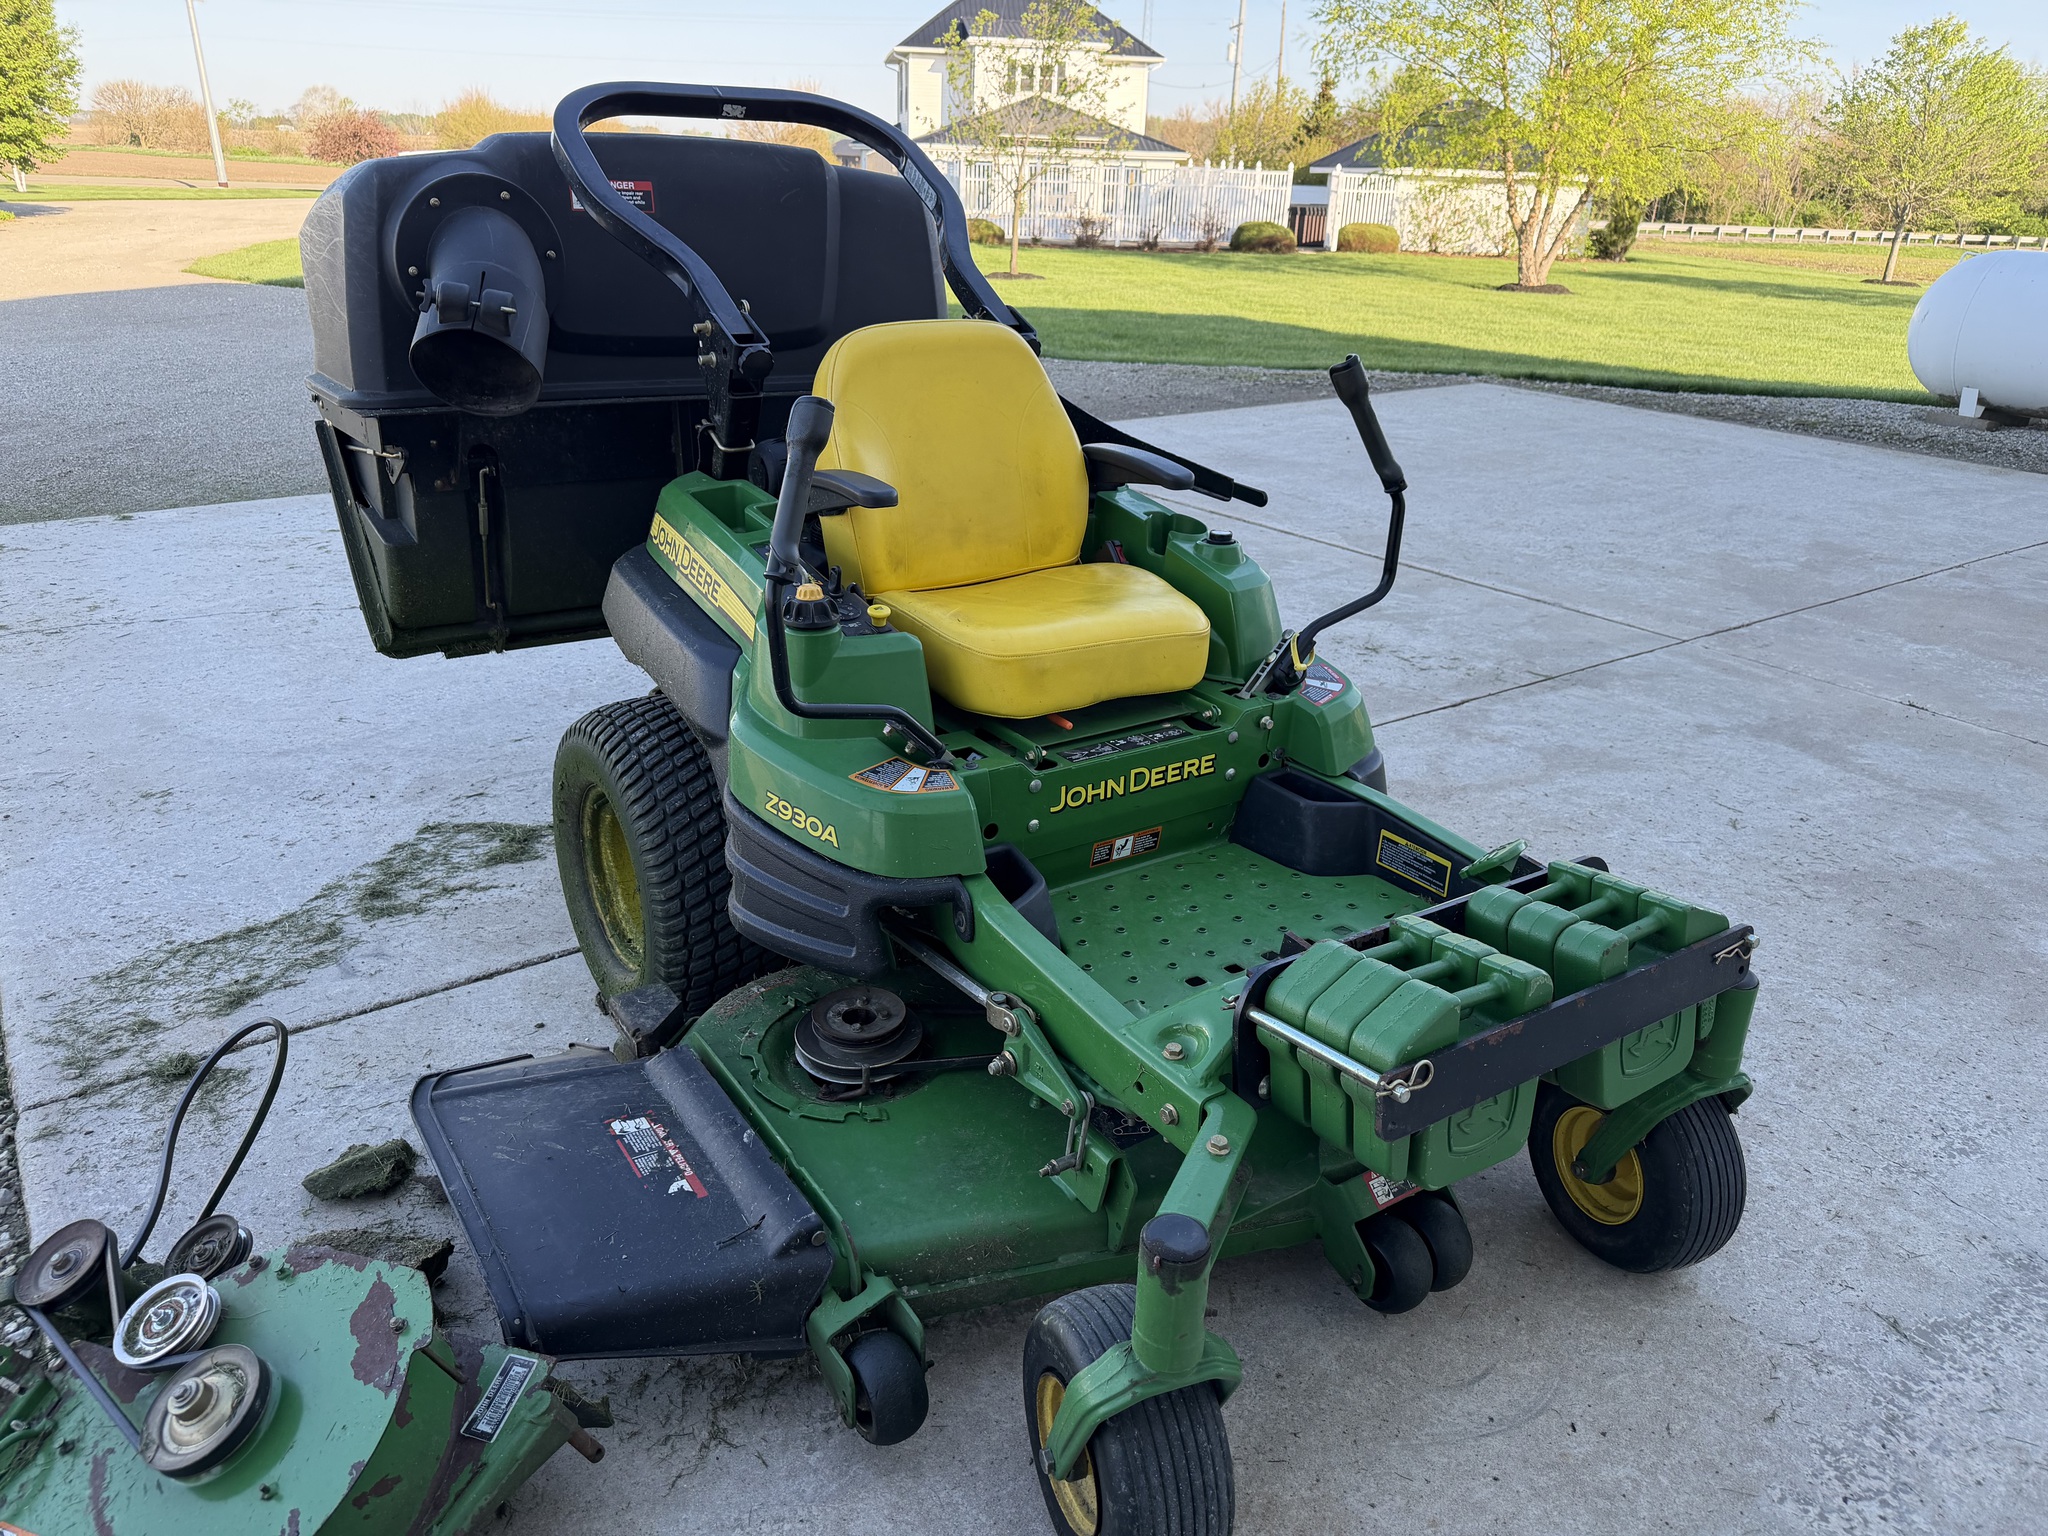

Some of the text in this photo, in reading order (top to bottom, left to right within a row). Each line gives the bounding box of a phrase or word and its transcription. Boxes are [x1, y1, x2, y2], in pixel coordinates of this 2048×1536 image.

[610, 181, 635, 190] NGER
[652, 519, 722, 603] JOHN DEERE
[1050, 753, 1217, 813] JOHN DEERE
[765, 790, 840, 849] Z930A
[474, 1397, 490, 1417] JOHN
[487, 1374, 504, 1398] DEERE
